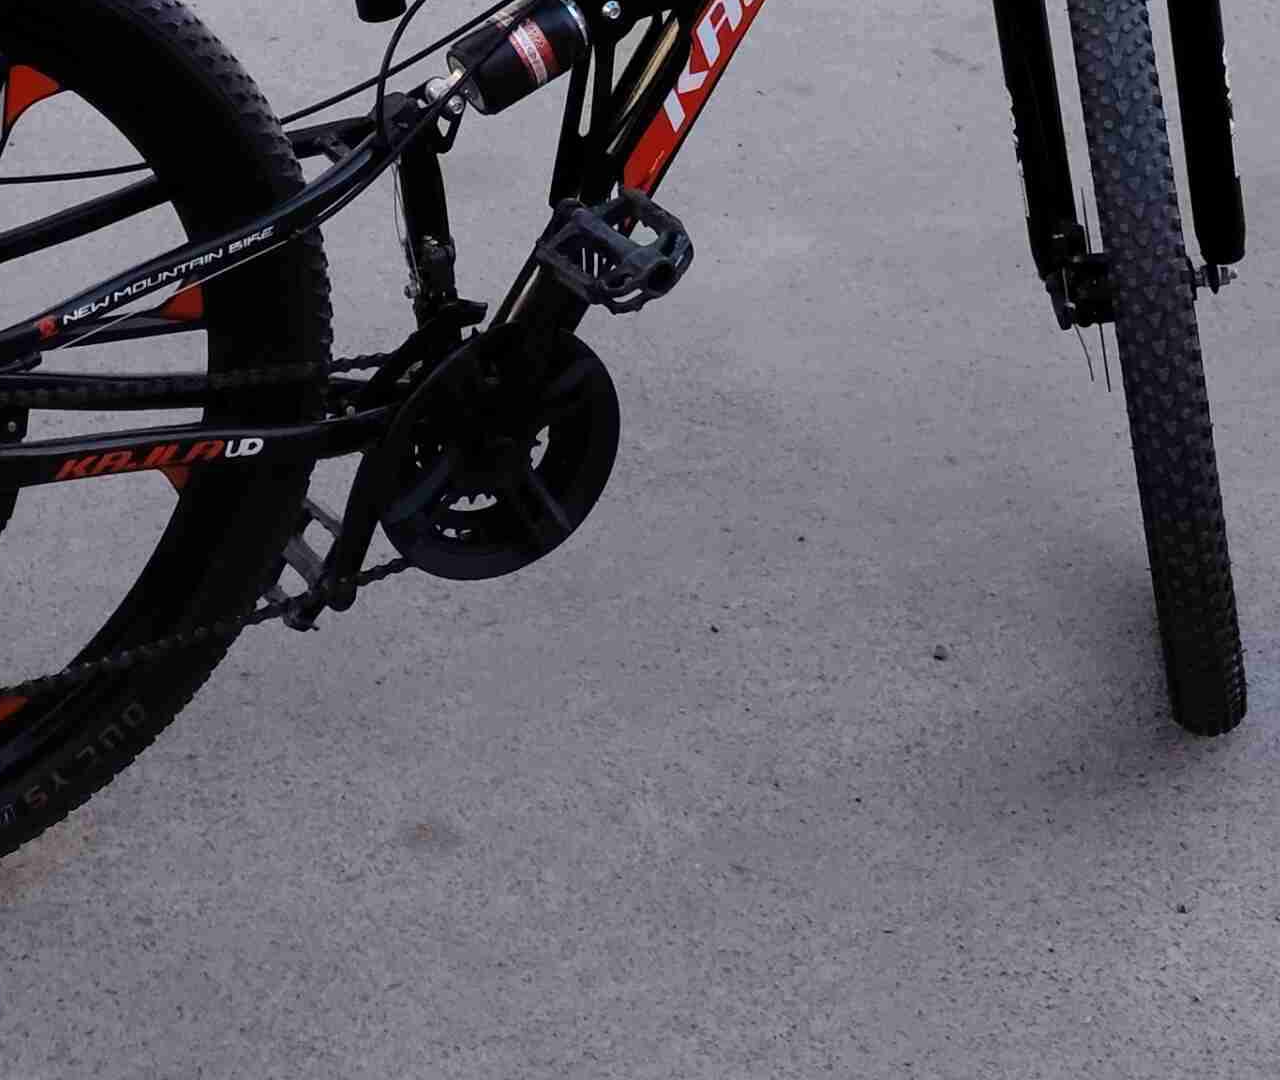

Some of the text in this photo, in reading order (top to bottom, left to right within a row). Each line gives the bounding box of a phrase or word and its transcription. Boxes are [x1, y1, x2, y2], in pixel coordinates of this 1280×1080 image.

[63, 225, 275, 325] NEW MOUNTAIN BIKE
